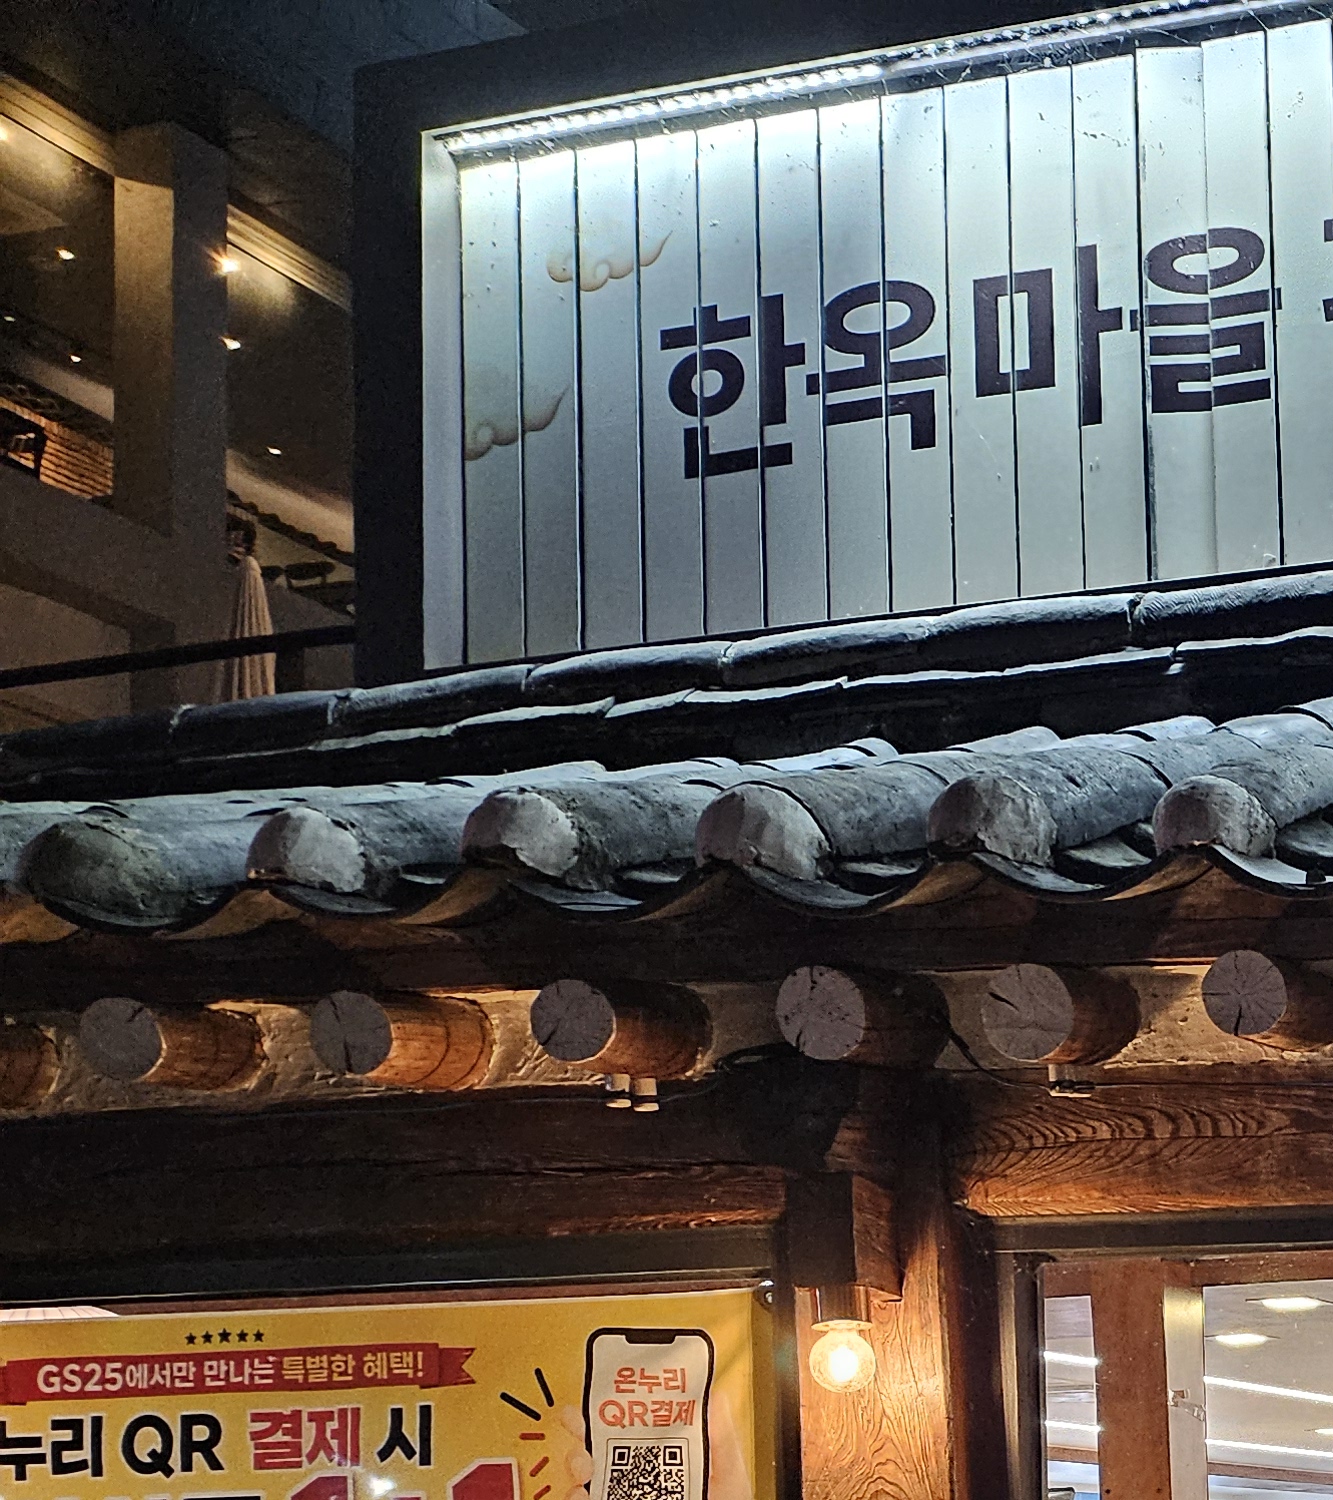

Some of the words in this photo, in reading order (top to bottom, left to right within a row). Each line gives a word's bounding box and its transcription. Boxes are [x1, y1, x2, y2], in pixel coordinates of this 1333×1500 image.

[656, 226, 1284, 480] 한옥마을
[37, 1361, 196, 1394] GS25에서만
[203, 1357, 276, 1387] 만나는
[281, 1355, 356, 1382] 특별한
[362, 1351, 424, 1380] 혜택!
[613, 1366, 688, 1394] 온누리
[598, 1400, 697, 1429] QR결제
[0, 1415, 104, 1481] 누리
[121, 1413, 225, 1478] QR
[249, 1406, 362, 1471] 결제
[377, 1404, 432, 1467] 시
